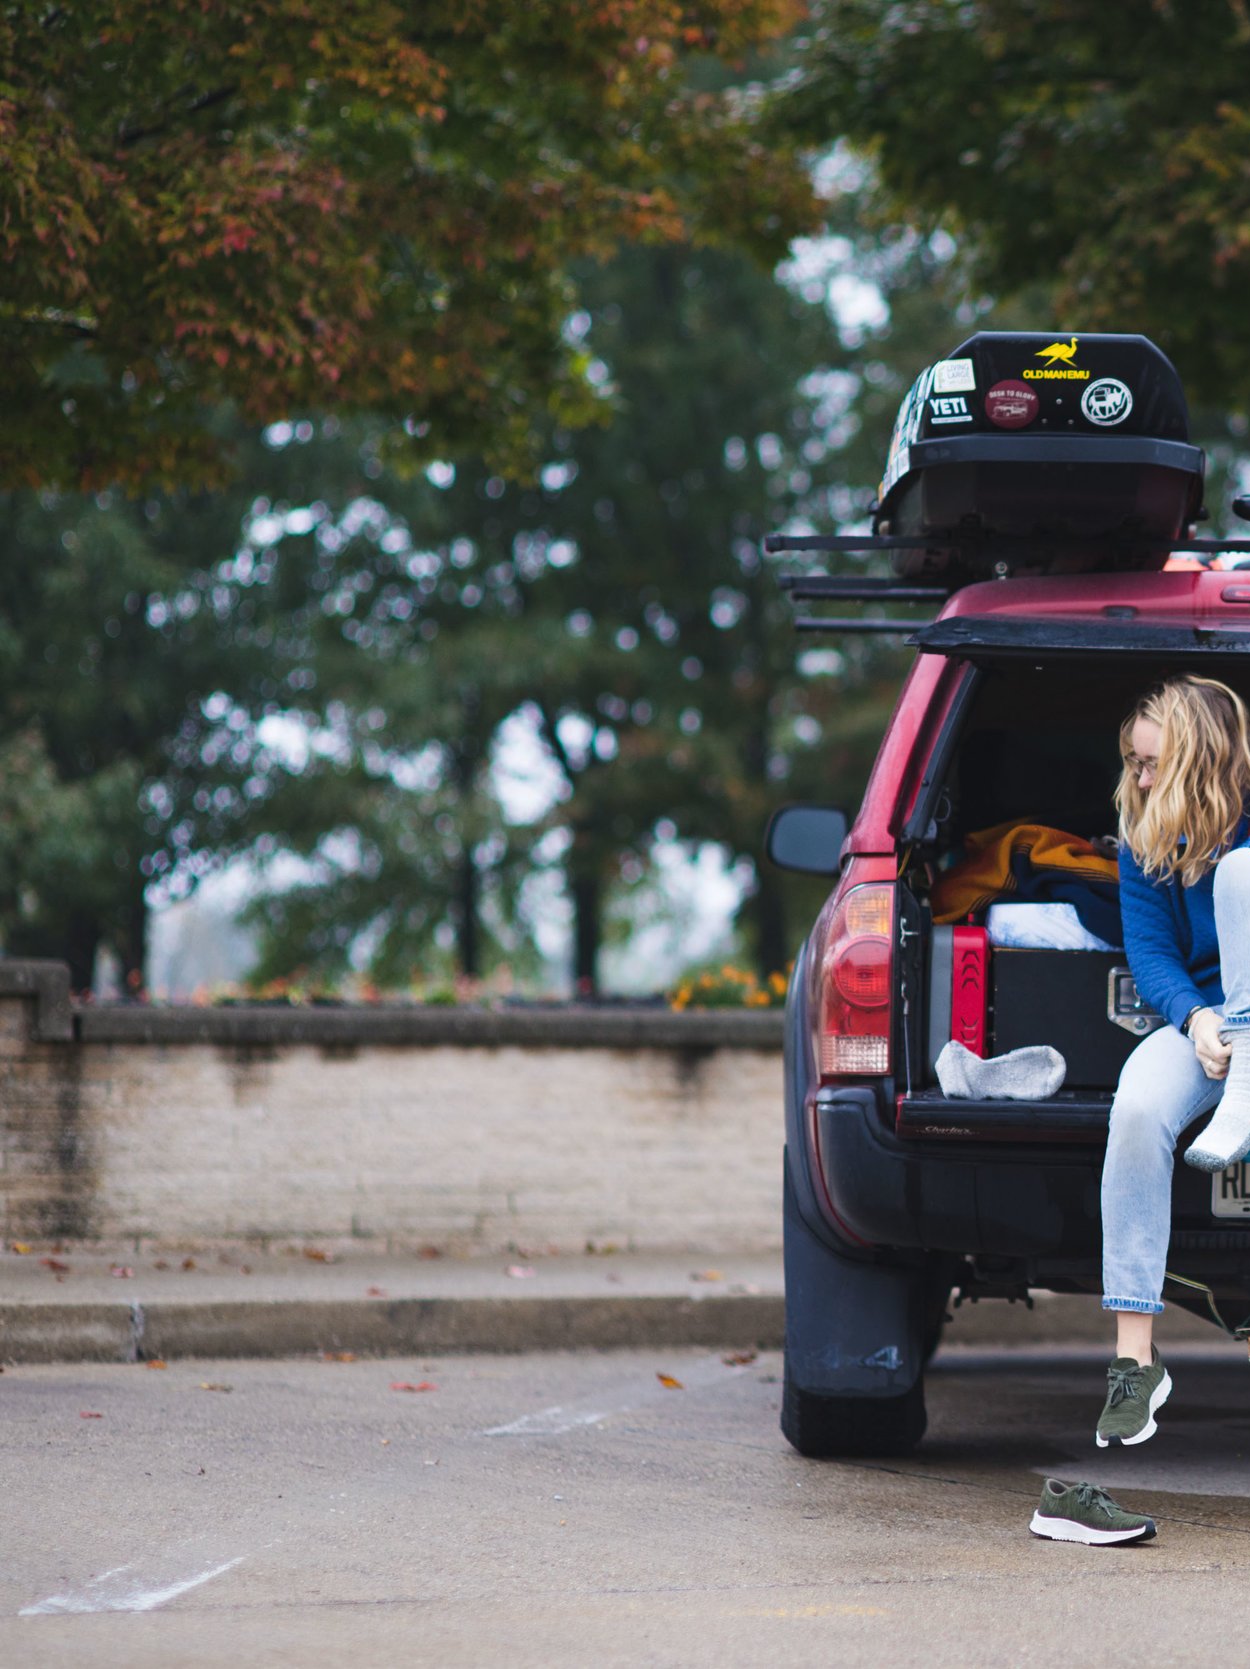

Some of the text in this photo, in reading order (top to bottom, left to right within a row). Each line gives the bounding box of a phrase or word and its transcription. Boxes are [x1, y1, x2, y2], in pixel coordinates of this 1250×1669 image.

[1023, 369, 1090, 379] OLD MAN EMU
[1006, 390, 1015, 398] TO
[1015, 391, 1037, 400] GLORY
[930, 397, 968, 415] YETI
